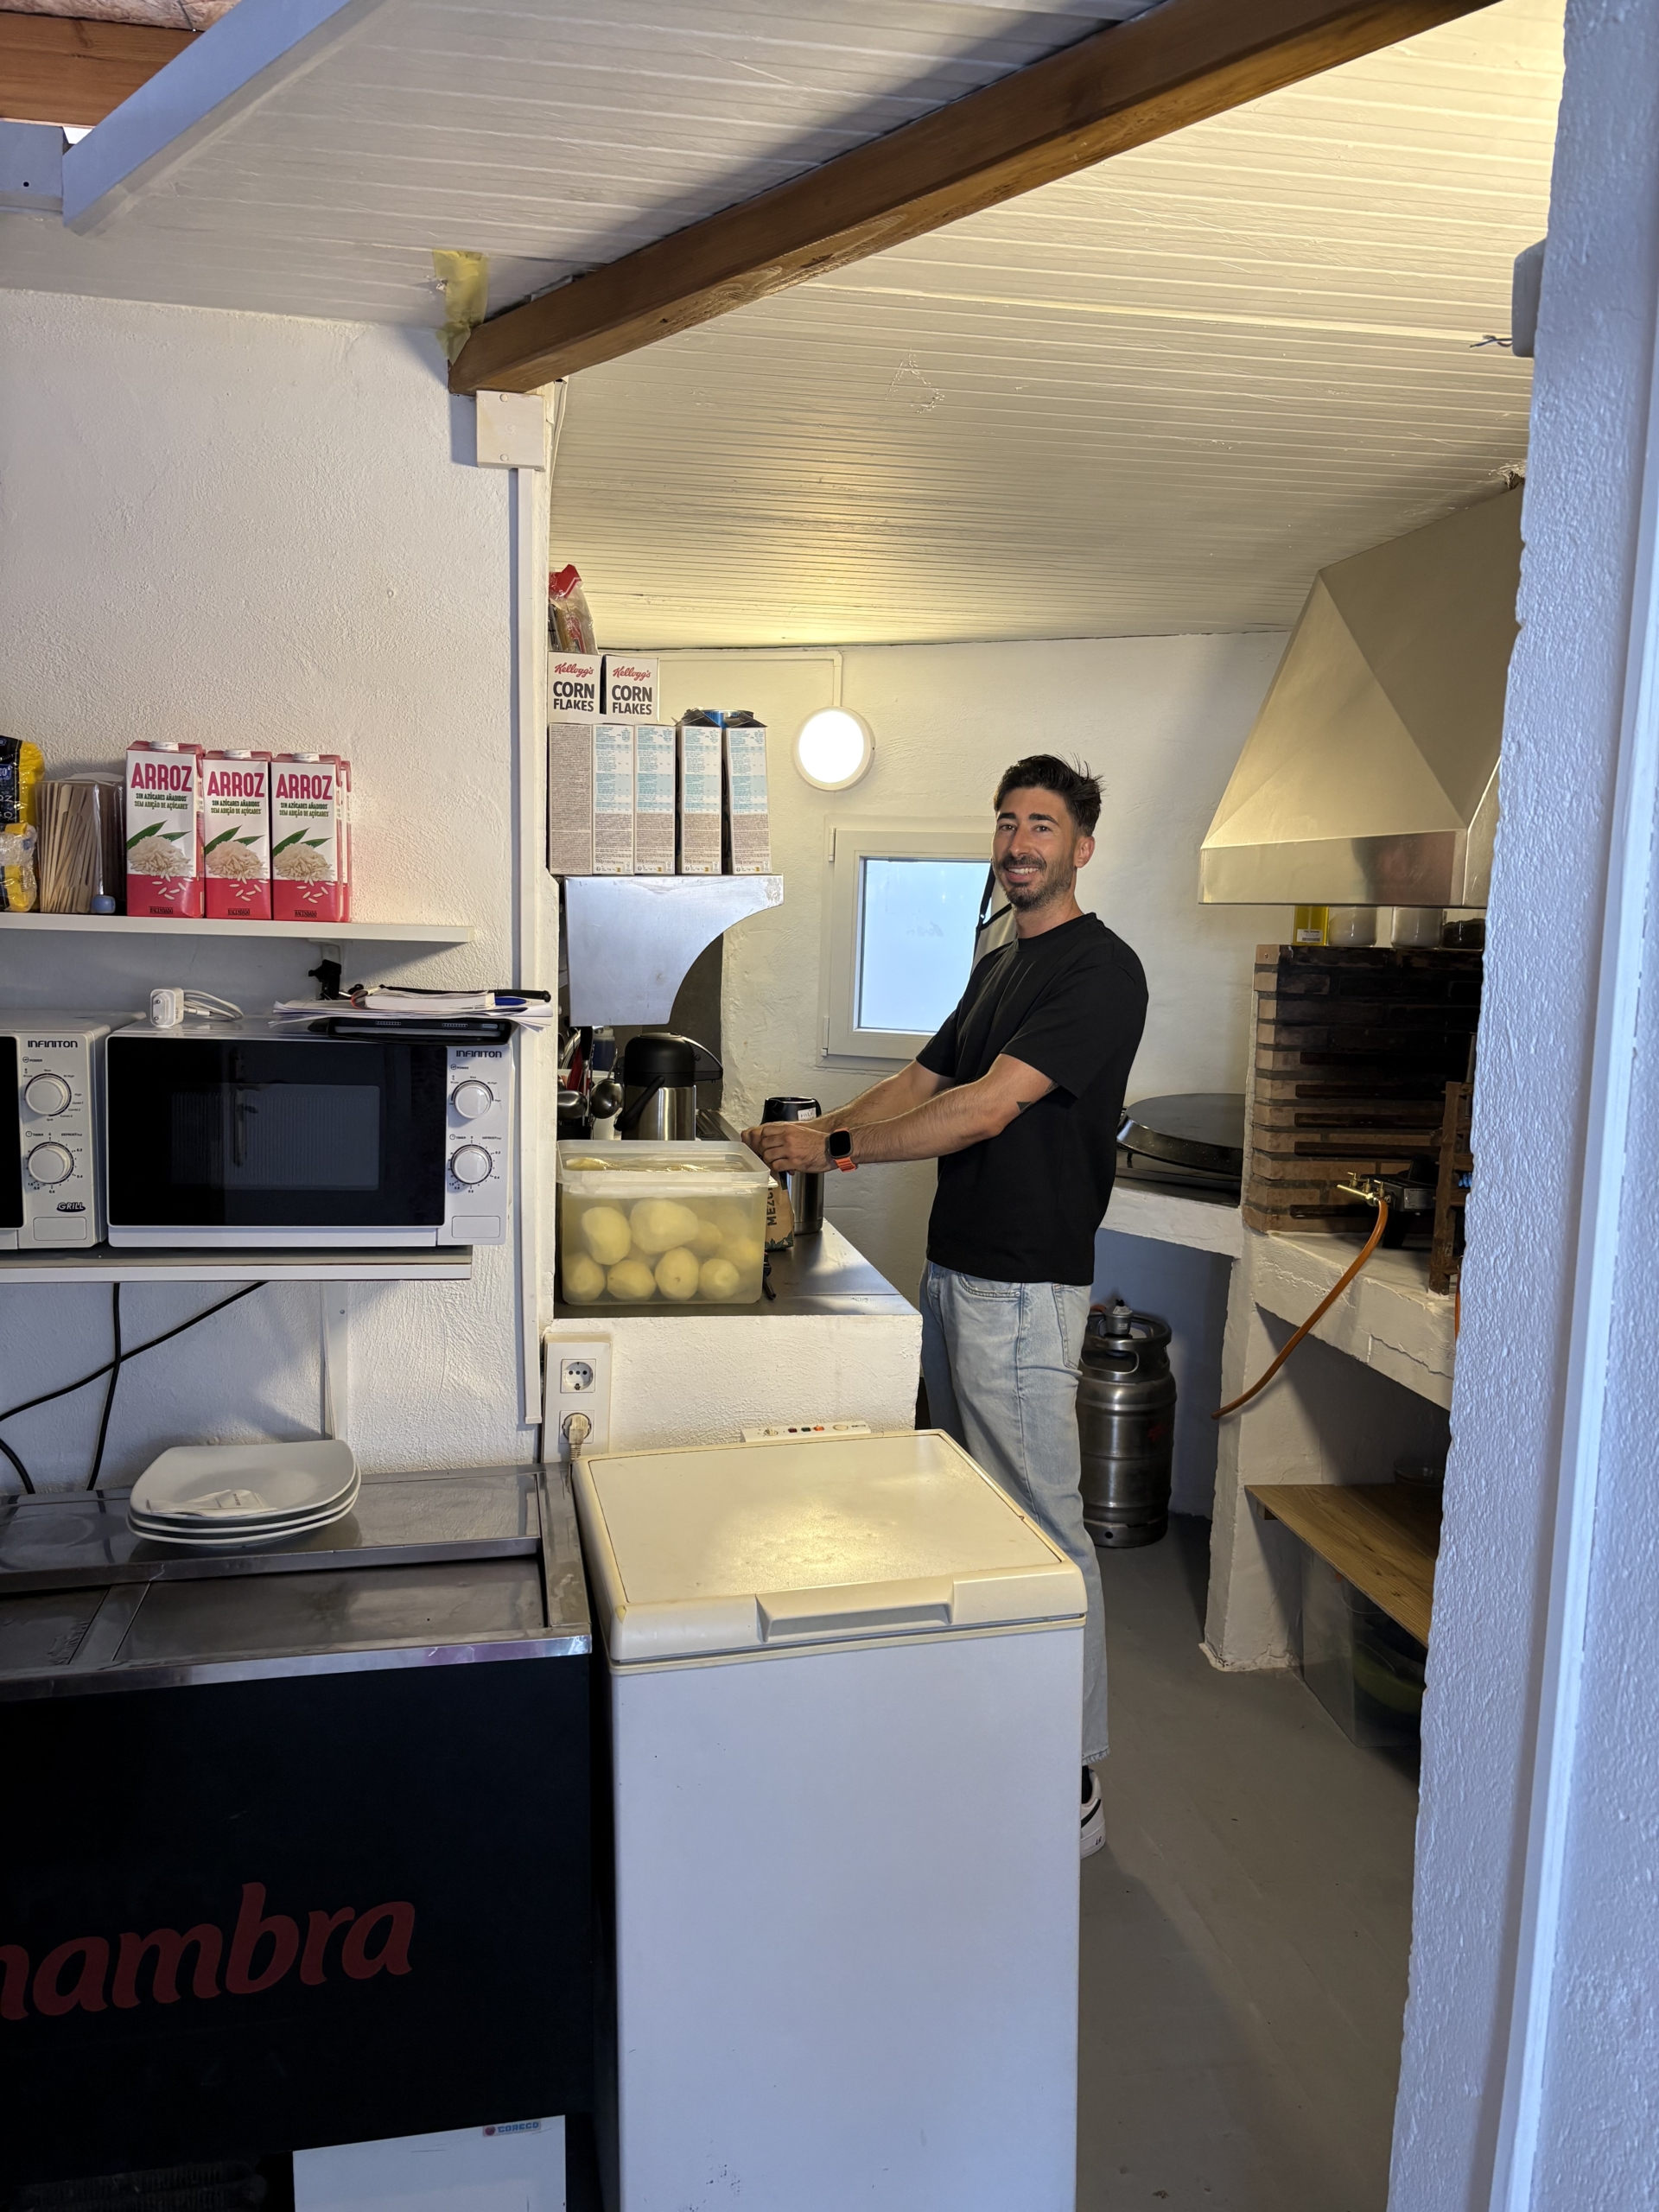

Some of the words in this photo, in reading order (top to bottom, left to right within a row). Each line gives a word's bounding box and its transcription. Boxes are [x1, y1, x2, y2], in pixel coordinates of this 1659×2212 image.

[554, 662, 594, 677] Kellogg's
[613, 666, 652, 681] Kellogg's
[553, 681, 594, 699] CORN
[612, 684, 652, 702] CORN
[553, 698, 594, 712] FLAKES
[612, 702, 652, 715] FLAKES
[130, 762, 193, 791] ARROZ
[207, 771, 264, 798] ARROZ
[276, 773, 333, 800] ARROZ
[455, 1050, 502, 1058] INFINITON
